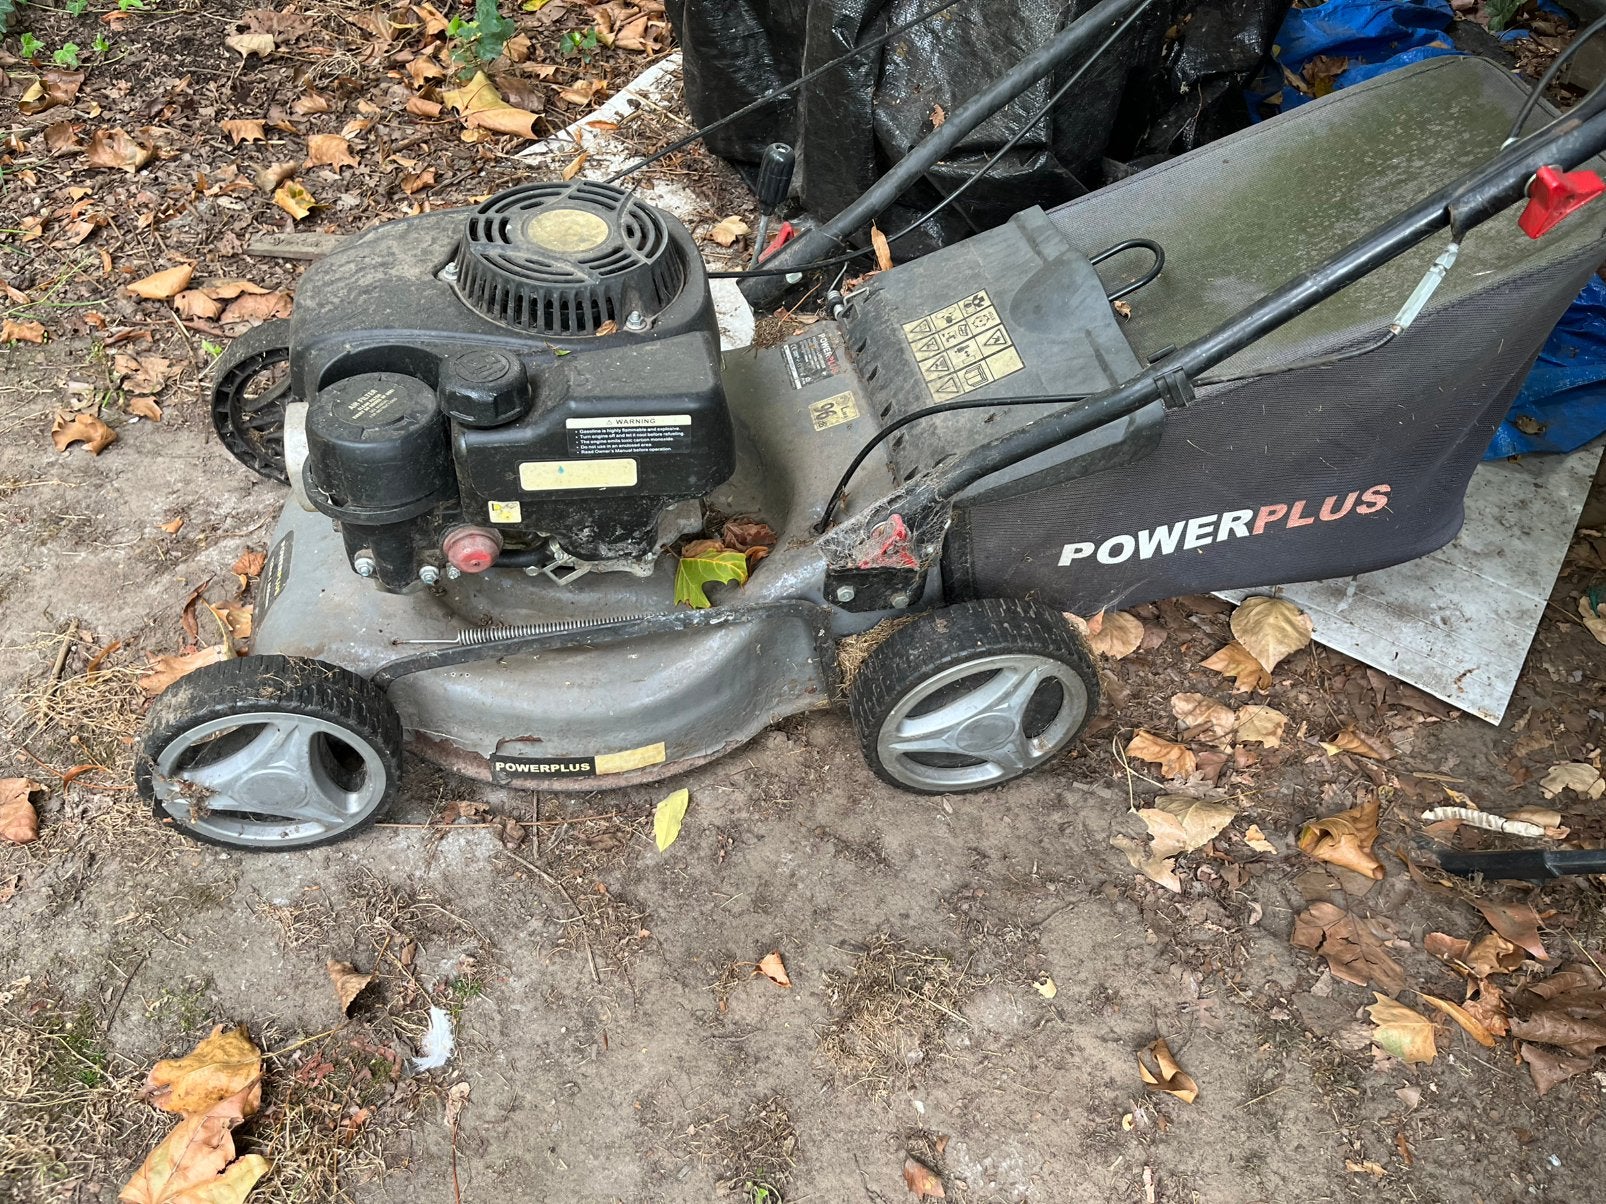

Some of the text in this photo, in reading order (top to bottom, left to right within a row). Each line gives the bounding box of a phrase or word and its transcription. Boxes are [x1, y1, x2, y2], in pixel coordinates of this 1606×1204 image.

[357, 389, 378, 403] FILTER
[814, 402, 837, 420] 96
[1057, 484, 1391, 566] POWERPLUS
[495, 762, 590, 773] POWERPLUS
